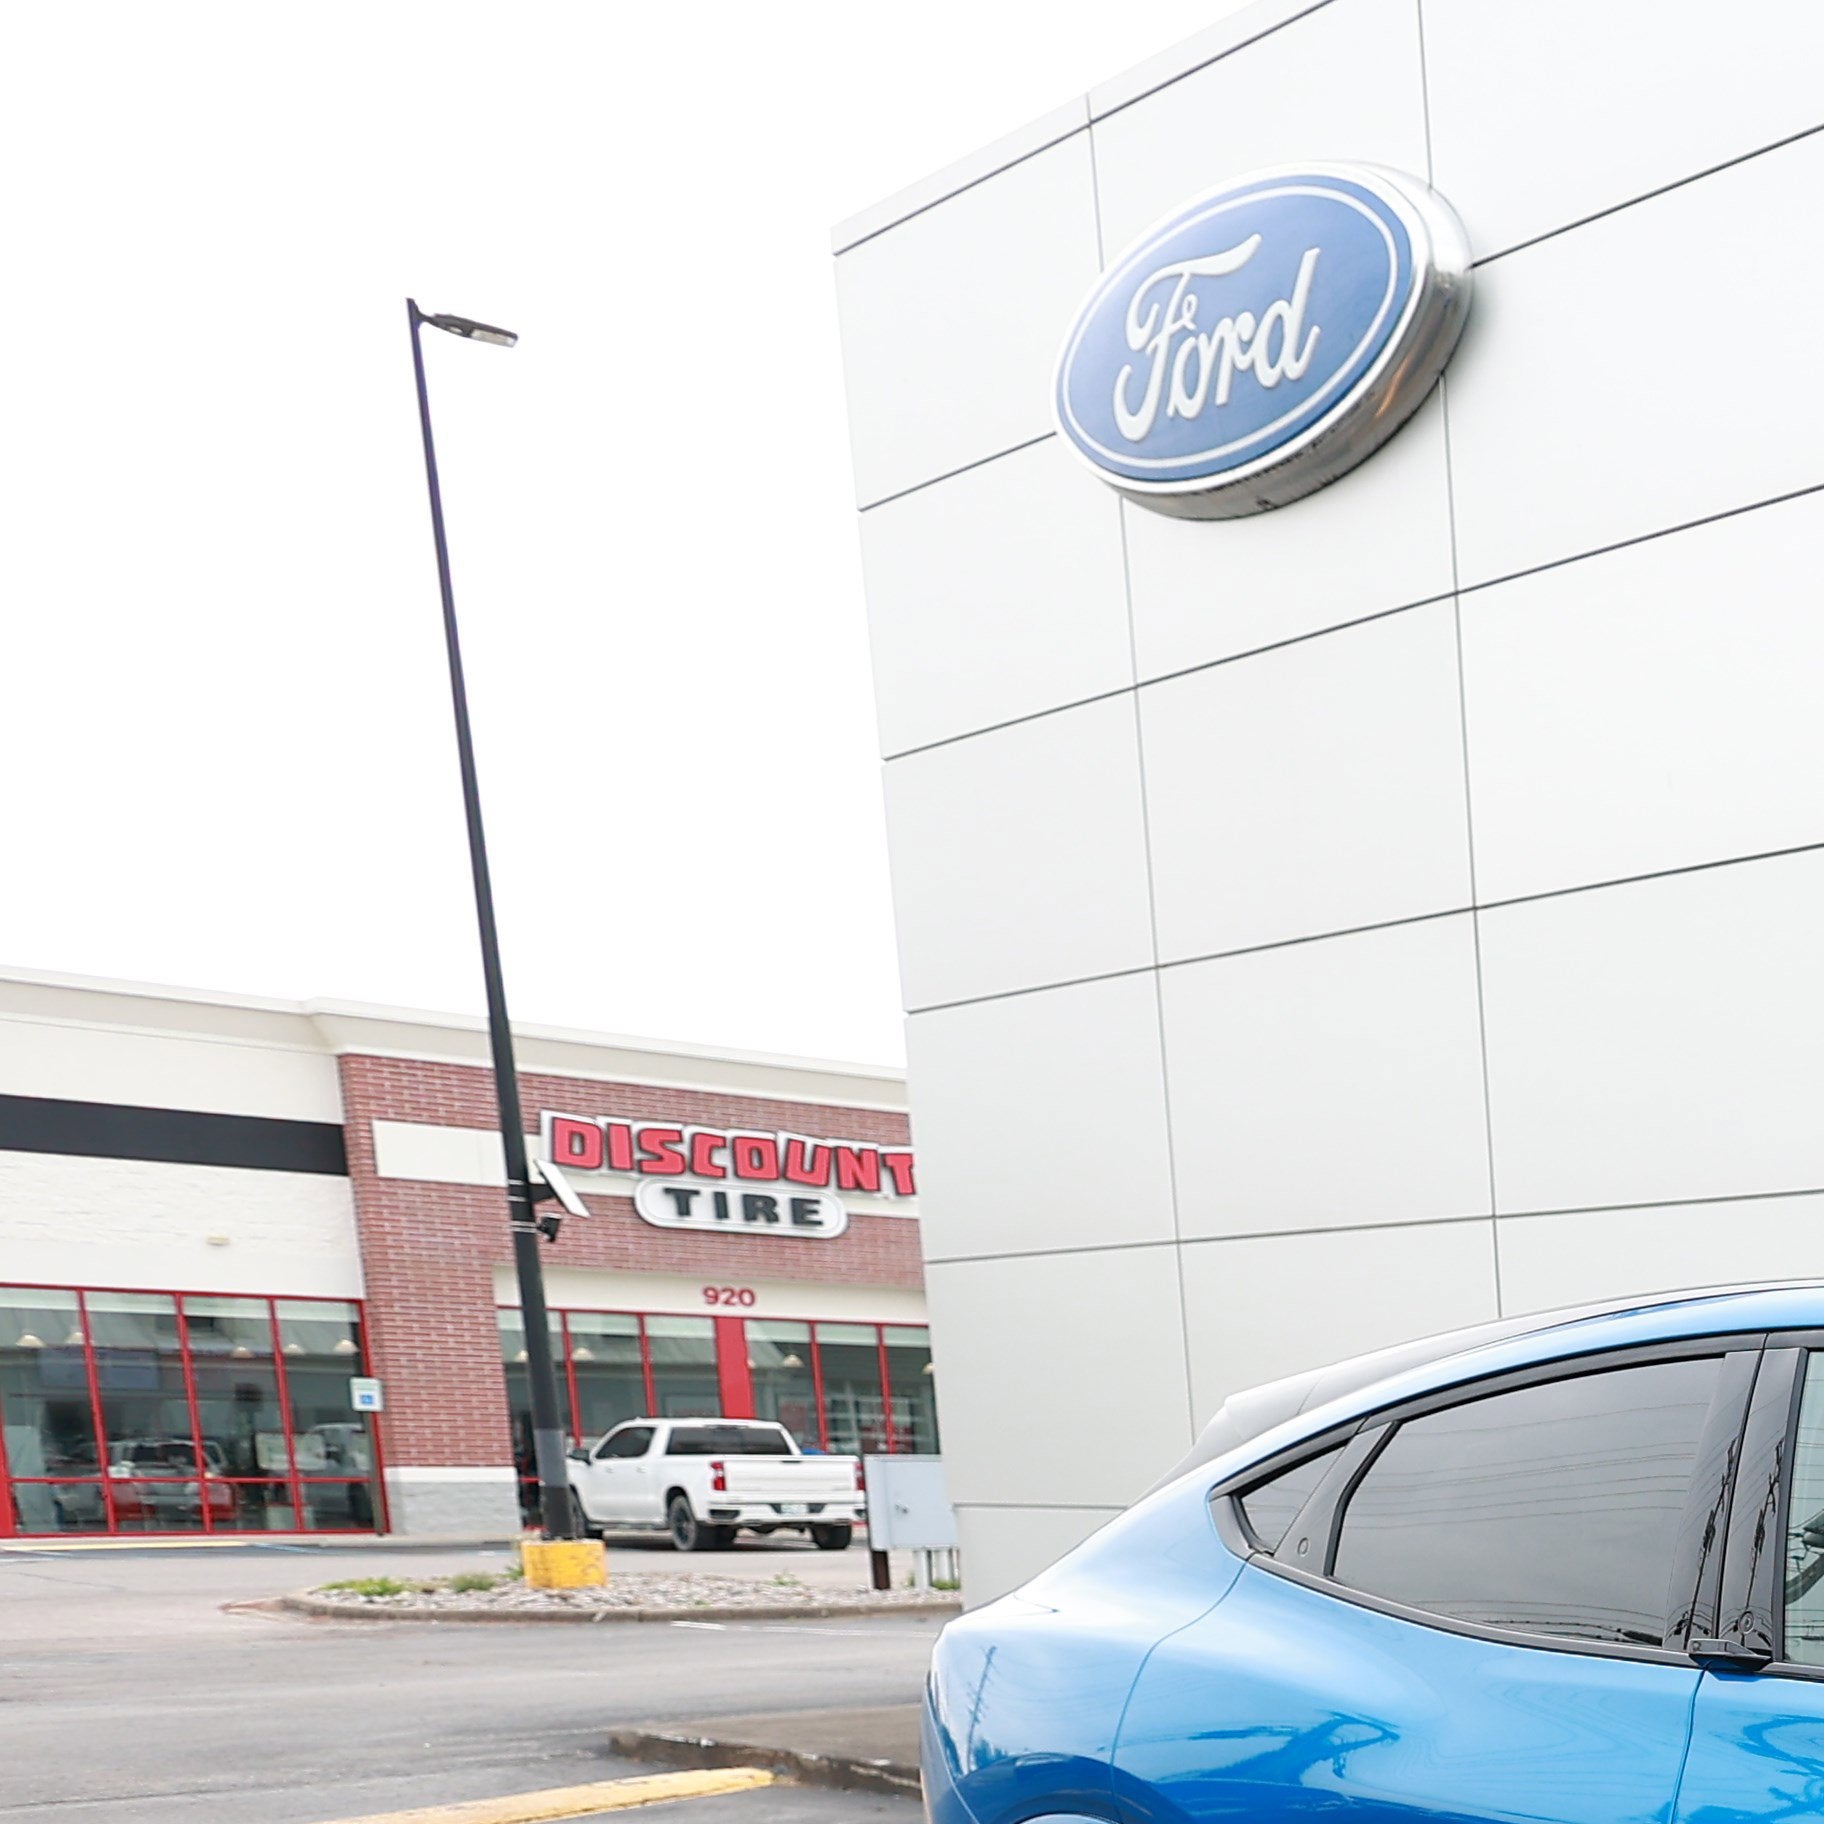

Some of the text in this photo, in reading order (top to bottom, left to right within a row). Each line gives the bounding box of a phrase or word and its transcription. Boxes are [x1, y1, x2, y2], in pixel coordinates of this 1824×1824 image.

[1112, 233, 1322, 443] Ford
[550, 1115, 917, 1197] DISCOUNT
[664, 1187, 826, 1227] TIRE
[702, 1286, 757, 1308] 920
